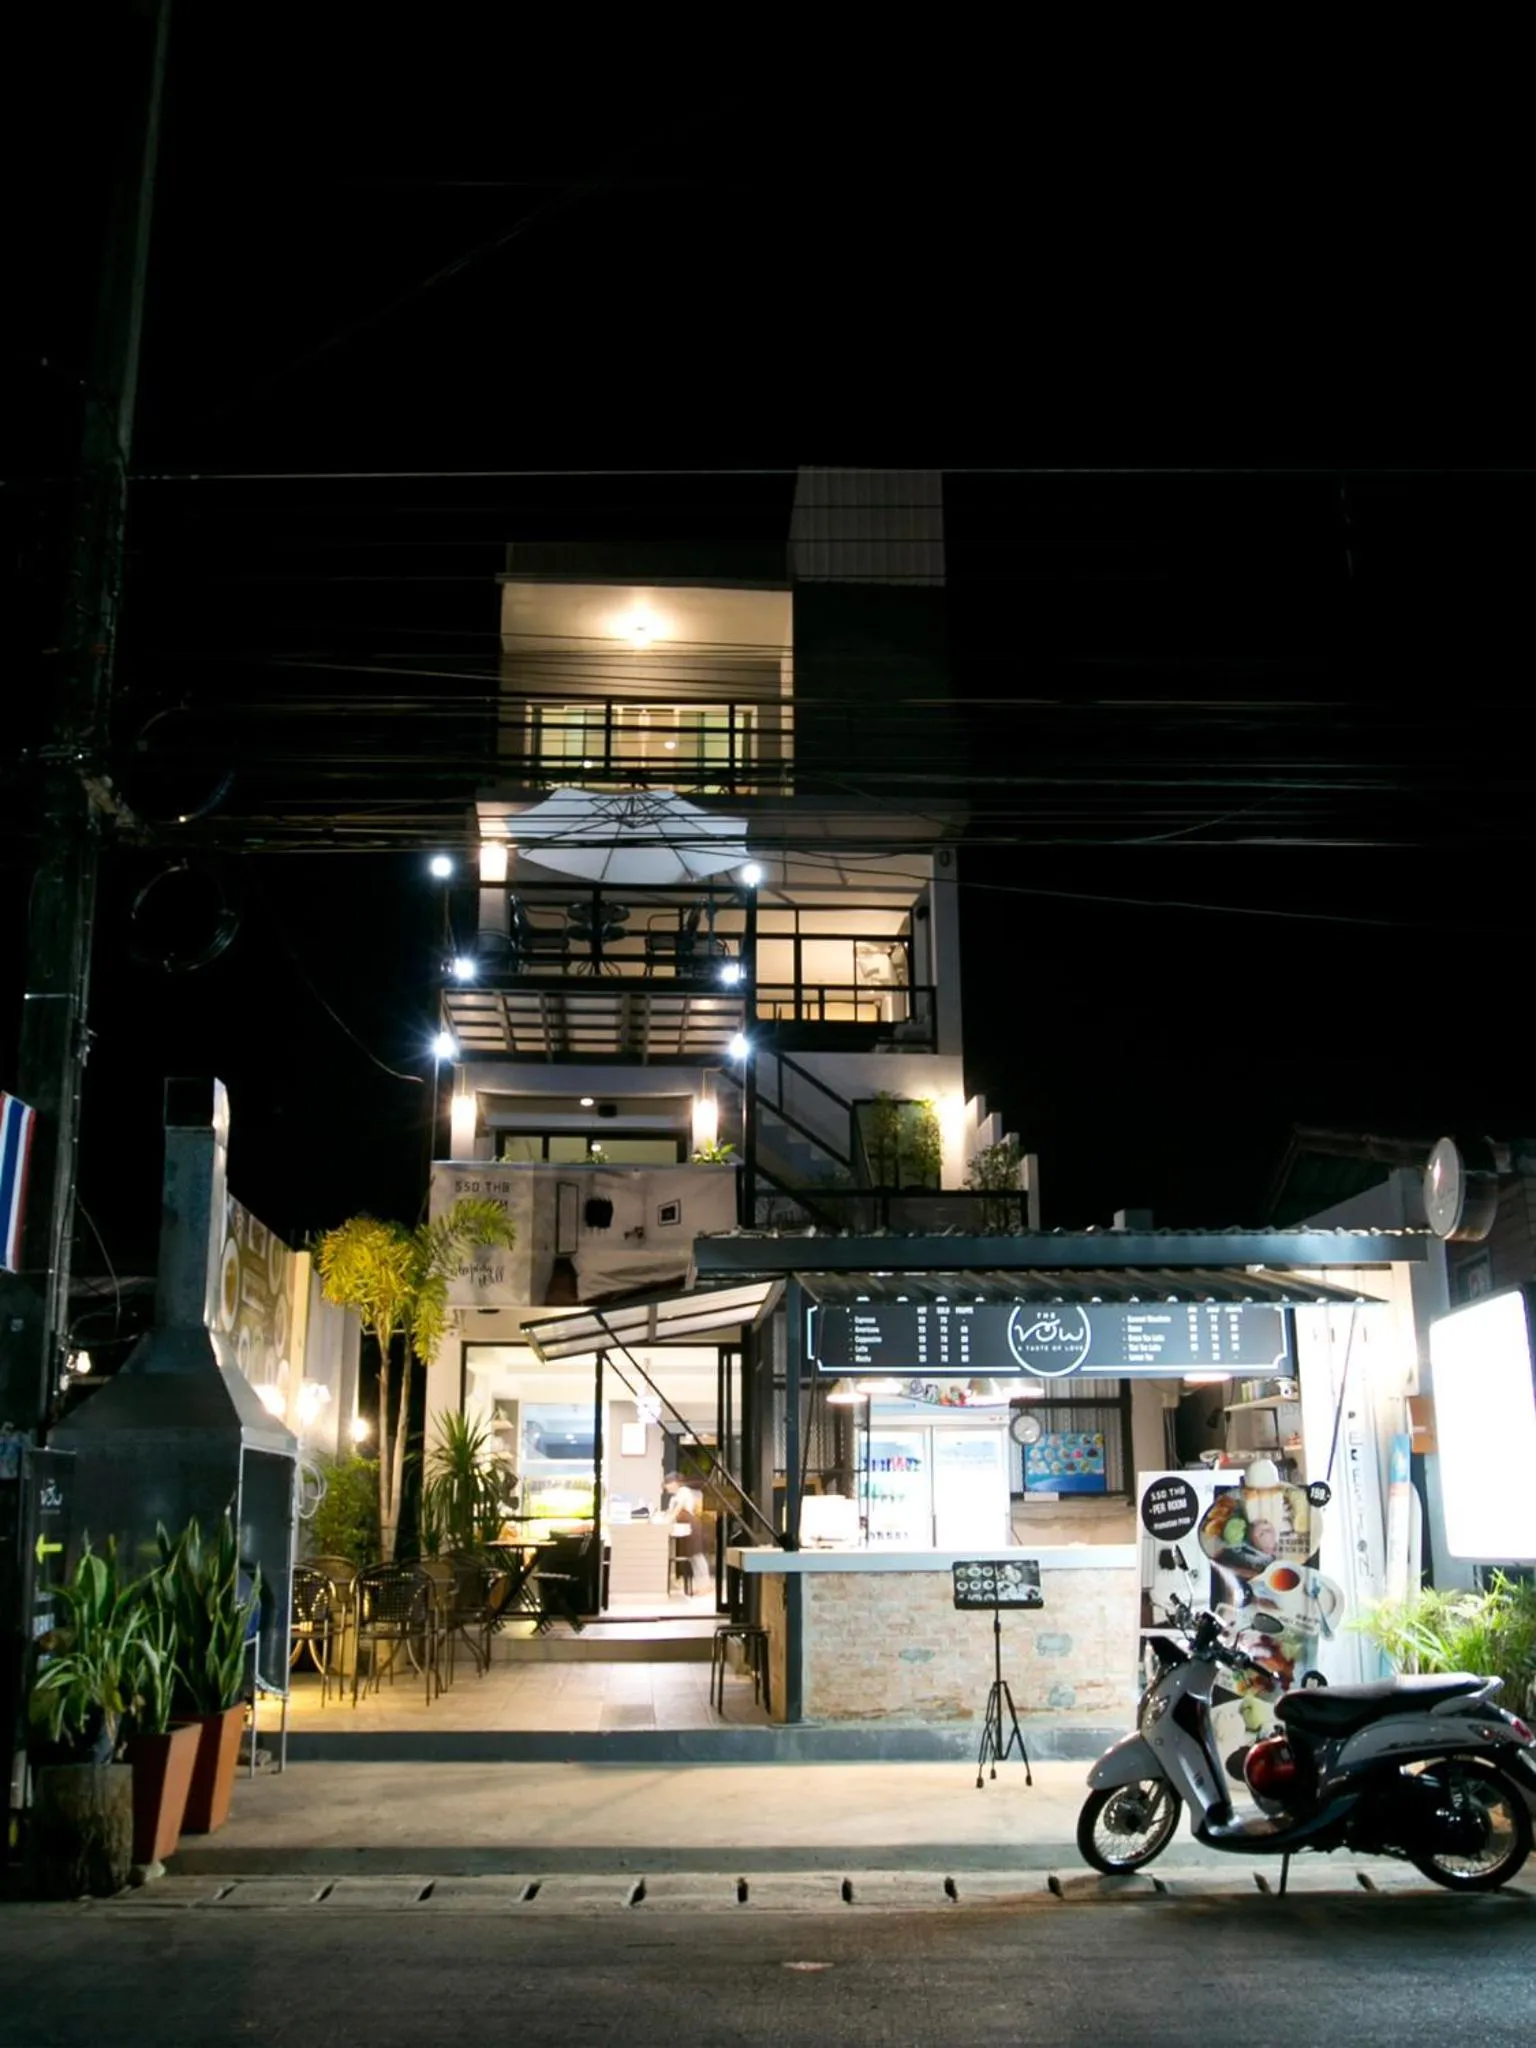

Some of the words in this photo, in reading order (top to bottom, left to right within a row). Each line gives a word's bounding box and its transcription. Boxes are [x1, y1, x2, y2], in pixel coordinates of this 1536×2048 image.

[485, 1181, 511, 1193] THB
[1152, 1502, 1166, 1515] PER
[1167, 1498, 1187, 1512] ROOM
